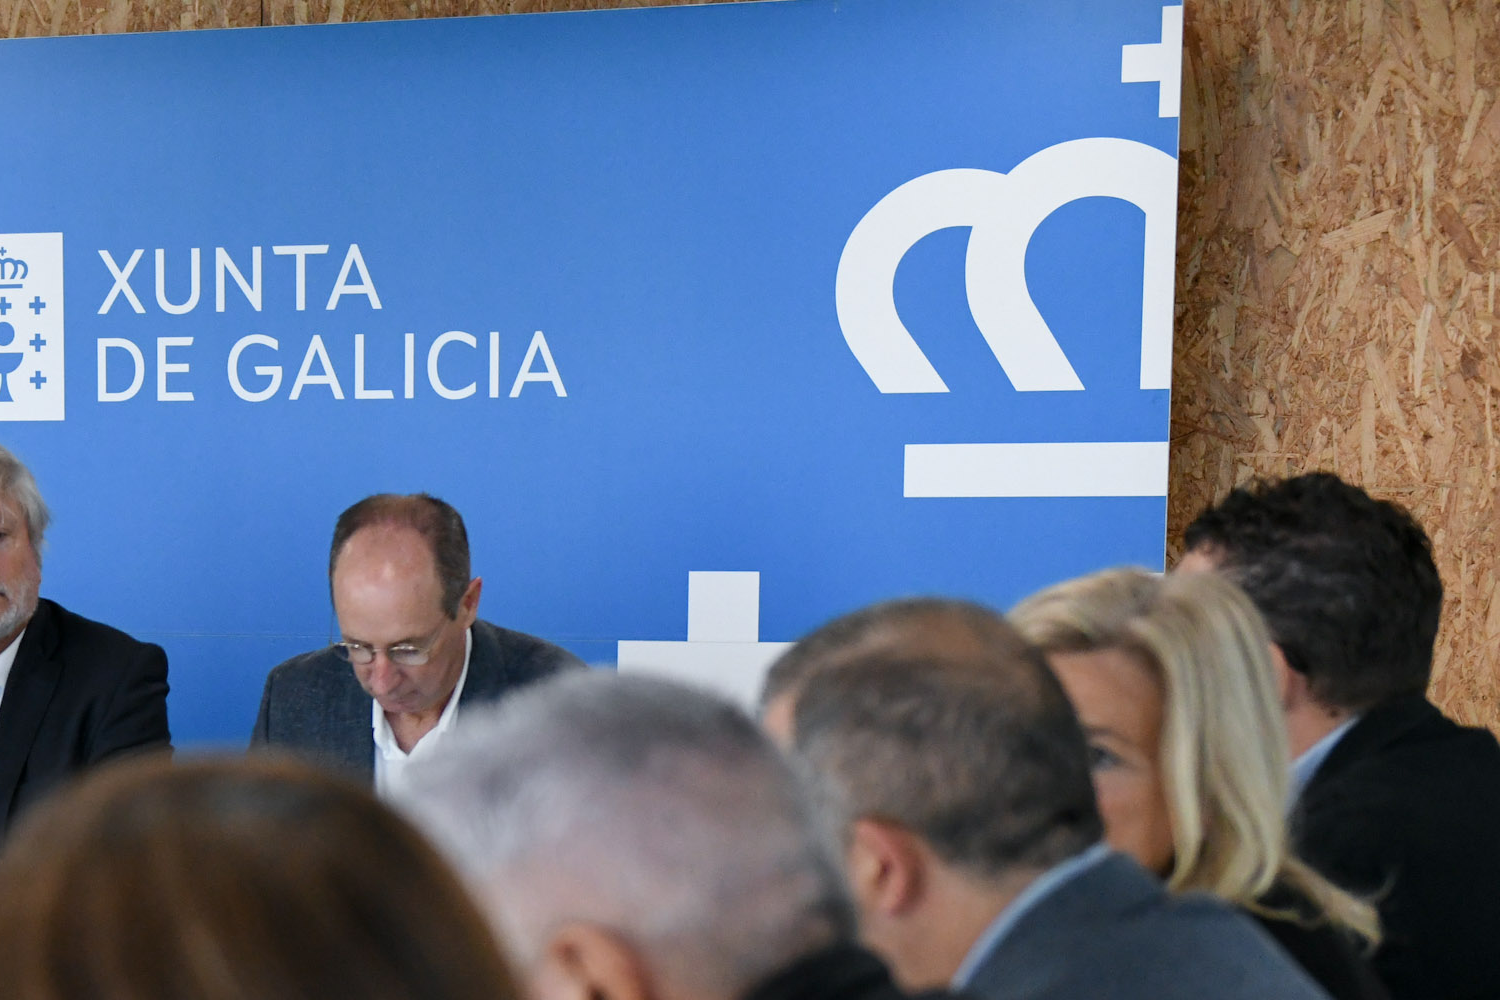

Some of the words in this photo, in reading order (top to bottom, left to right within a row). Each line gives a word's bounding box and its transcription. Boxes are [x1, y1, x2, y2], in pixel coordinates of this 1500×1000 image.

[97, 243, 382, 315] XUNTA
[97, 336, 194, 402] DE
[227, 330, 568, 402] GALICIA
